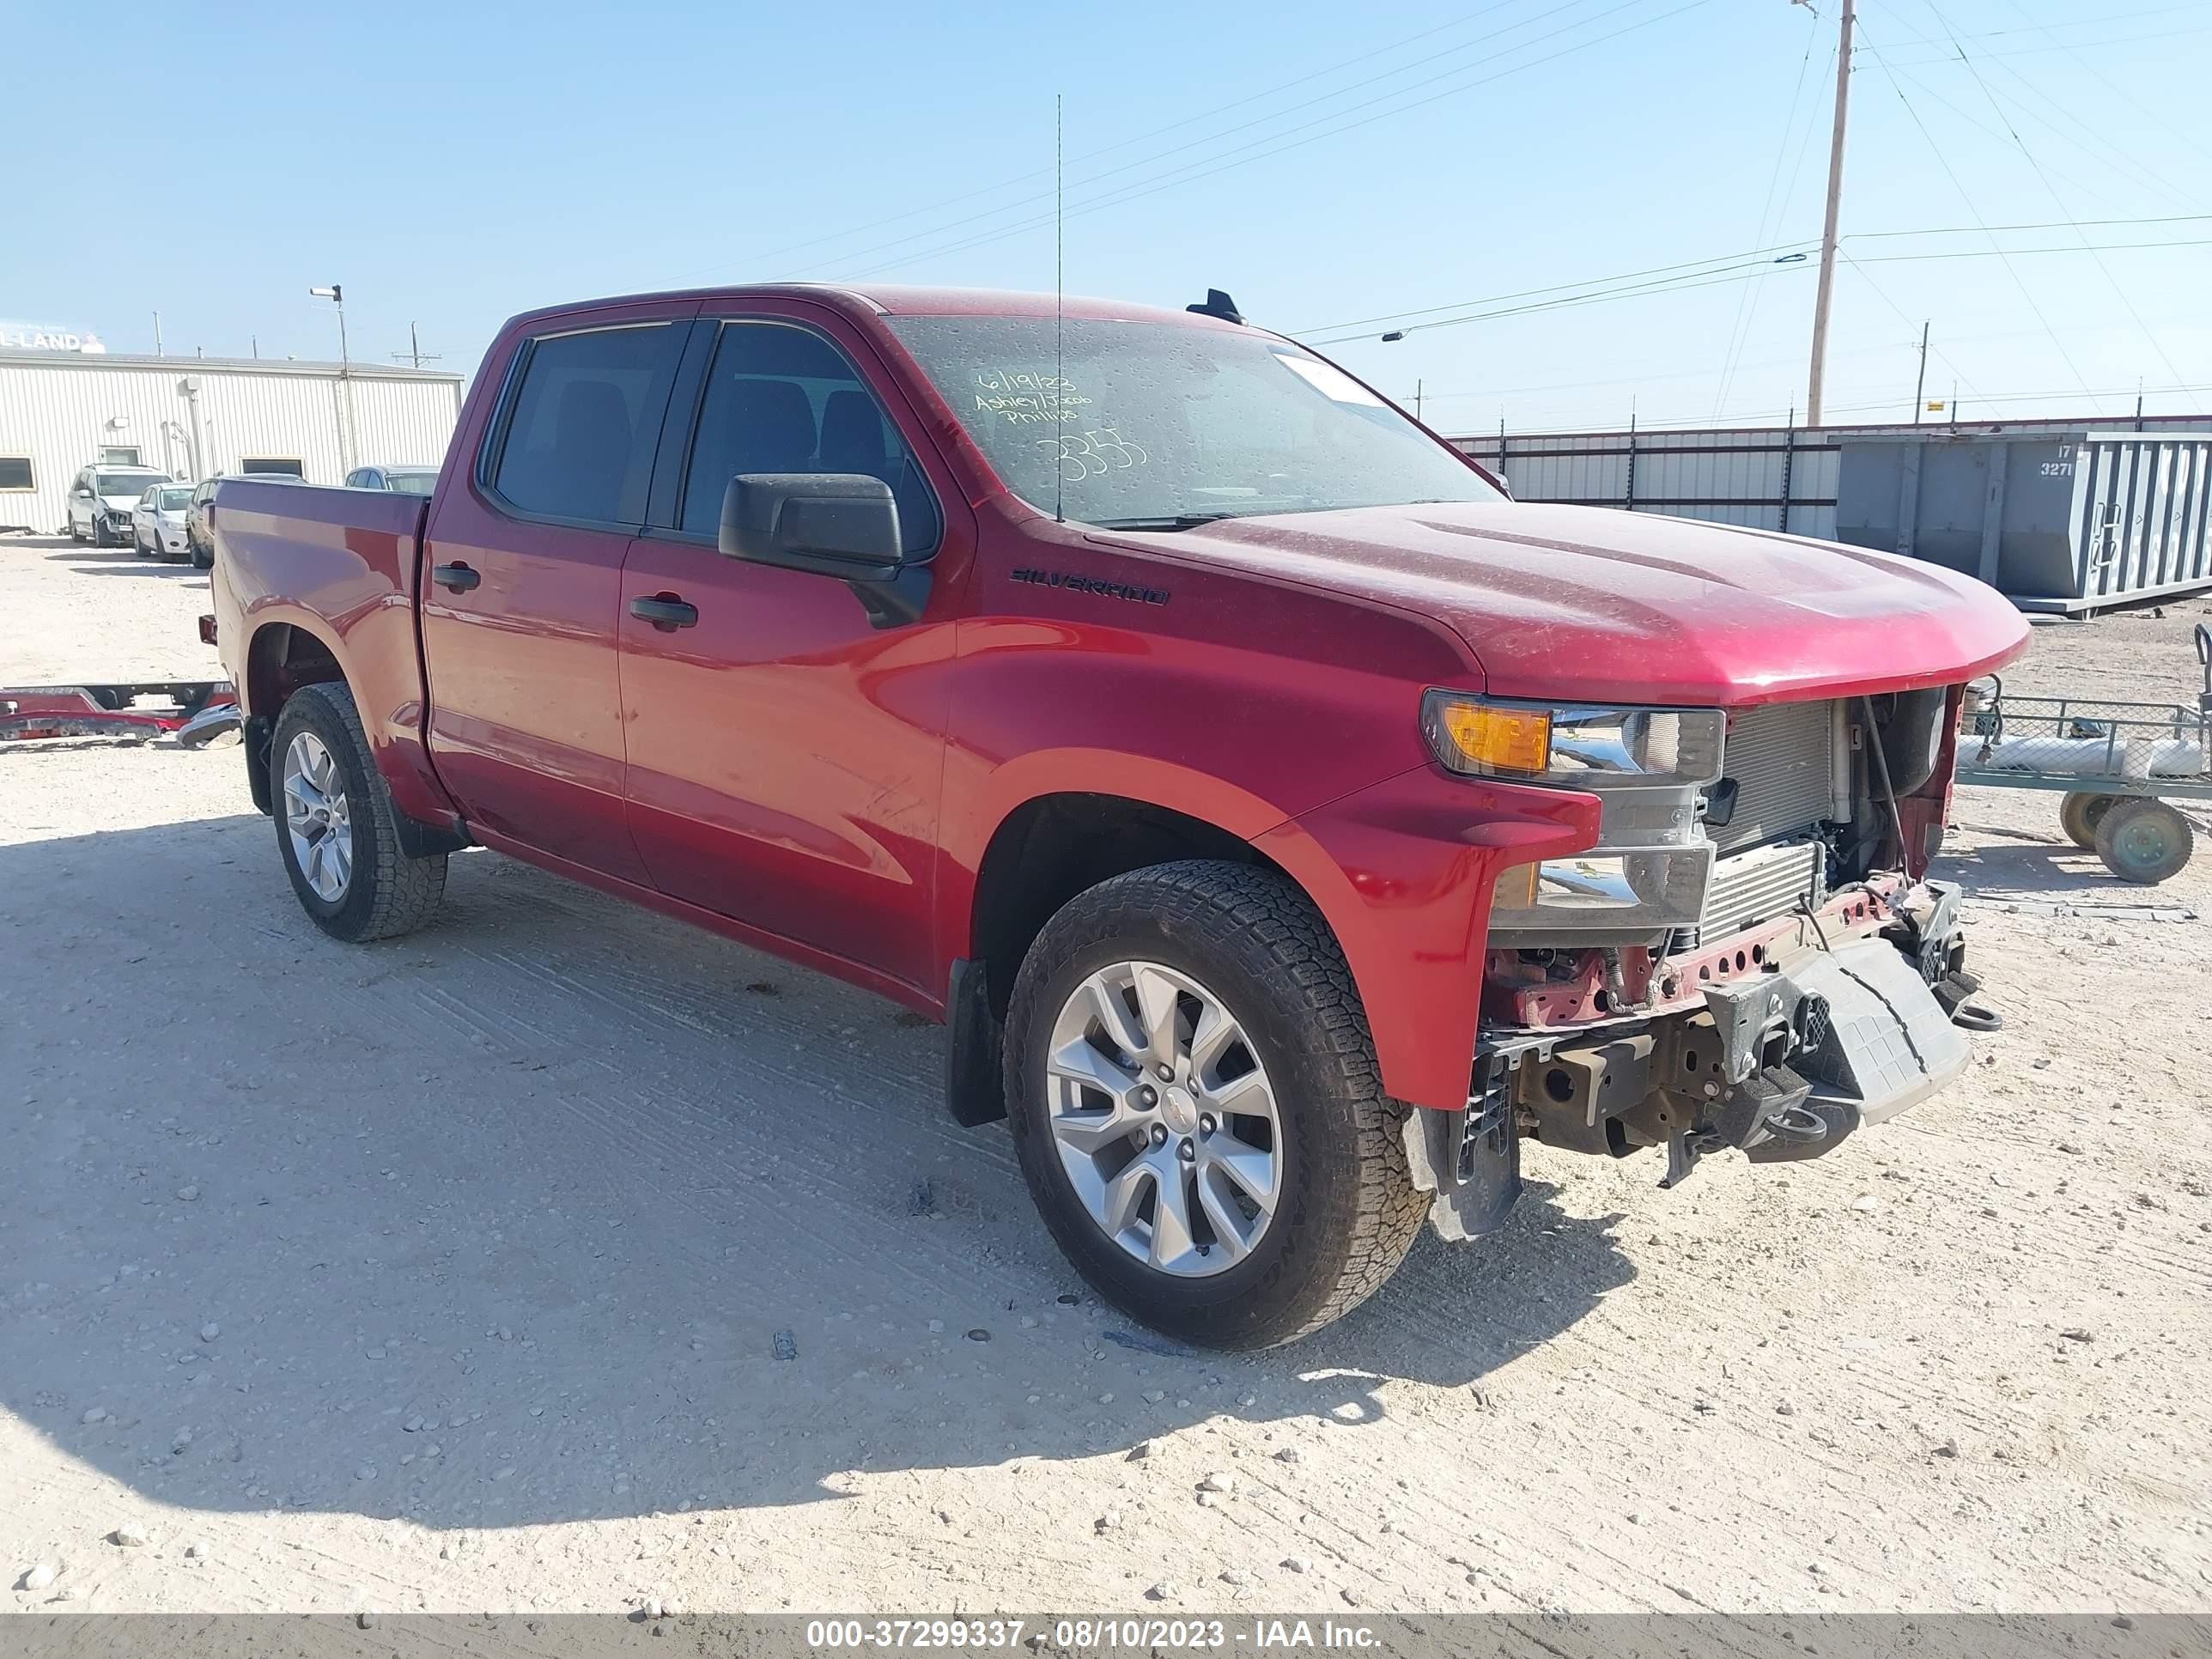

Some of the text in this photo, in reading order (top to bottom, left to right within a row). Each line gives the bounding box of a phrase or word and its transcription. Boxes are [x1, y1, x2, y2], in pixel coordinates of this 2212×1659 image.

[20, 332, 80, 350] LAND
[978, 371, 1077, 392] 6/19/23
[998, 411, 1079, 425] Phillips
[1036, 428, 1148, 482] 3355
[2058, 446, 2071, 459] 17
[2040, 463, 2072, 477] 3271
[1009, 568, 1171, 606] SILVERADO
